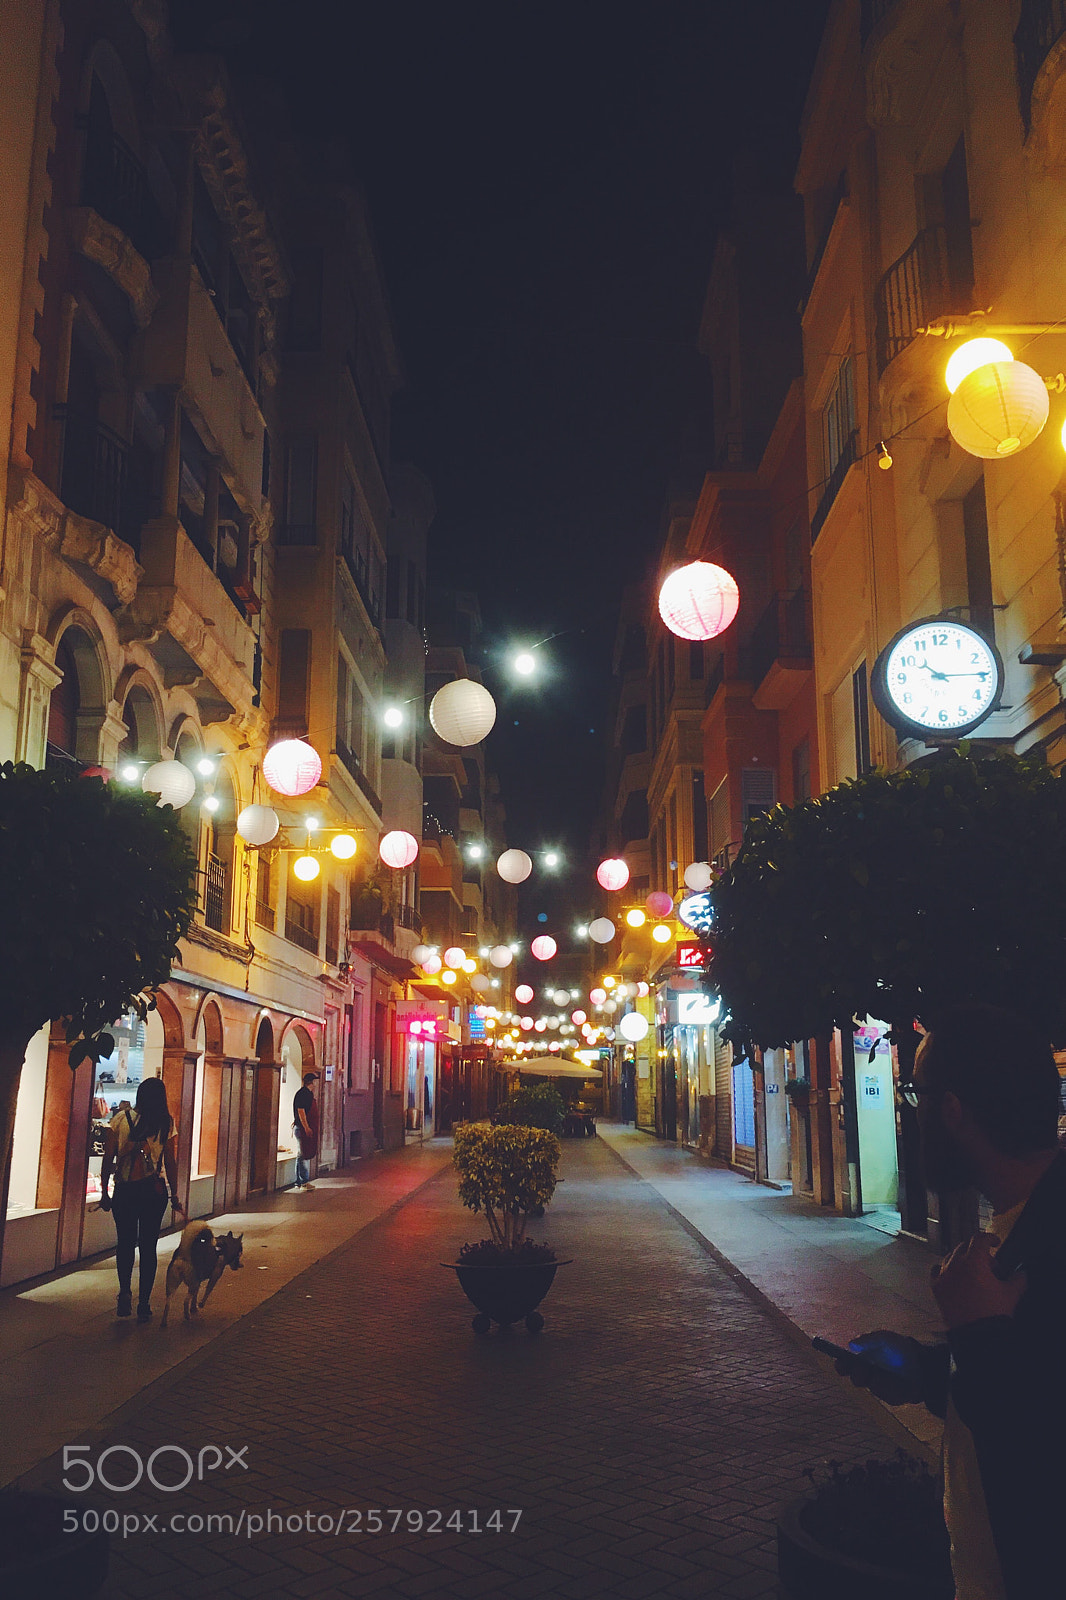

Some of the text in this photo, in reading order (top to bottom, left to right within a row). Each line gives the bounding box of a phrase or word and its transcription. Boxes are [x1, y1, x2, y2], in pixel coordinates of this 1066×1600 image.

[914, 640, 926, 651] 11
[932, 634, 948, 646] 12
[955, 639, 961, 650] 1
[900, 655, 916, 667] 10
[970, 653, 980, 664] 2
[897, 673, 907, 684] 9
[903, 692, 912, 704] 8
[972, 689, 982, 700] 4
[920, 706, 929, 718] 7
[938, 710, 948, 722] 6
[958, 705, 968, 717] 5
[865, 1087, 880, 1096] IBI
